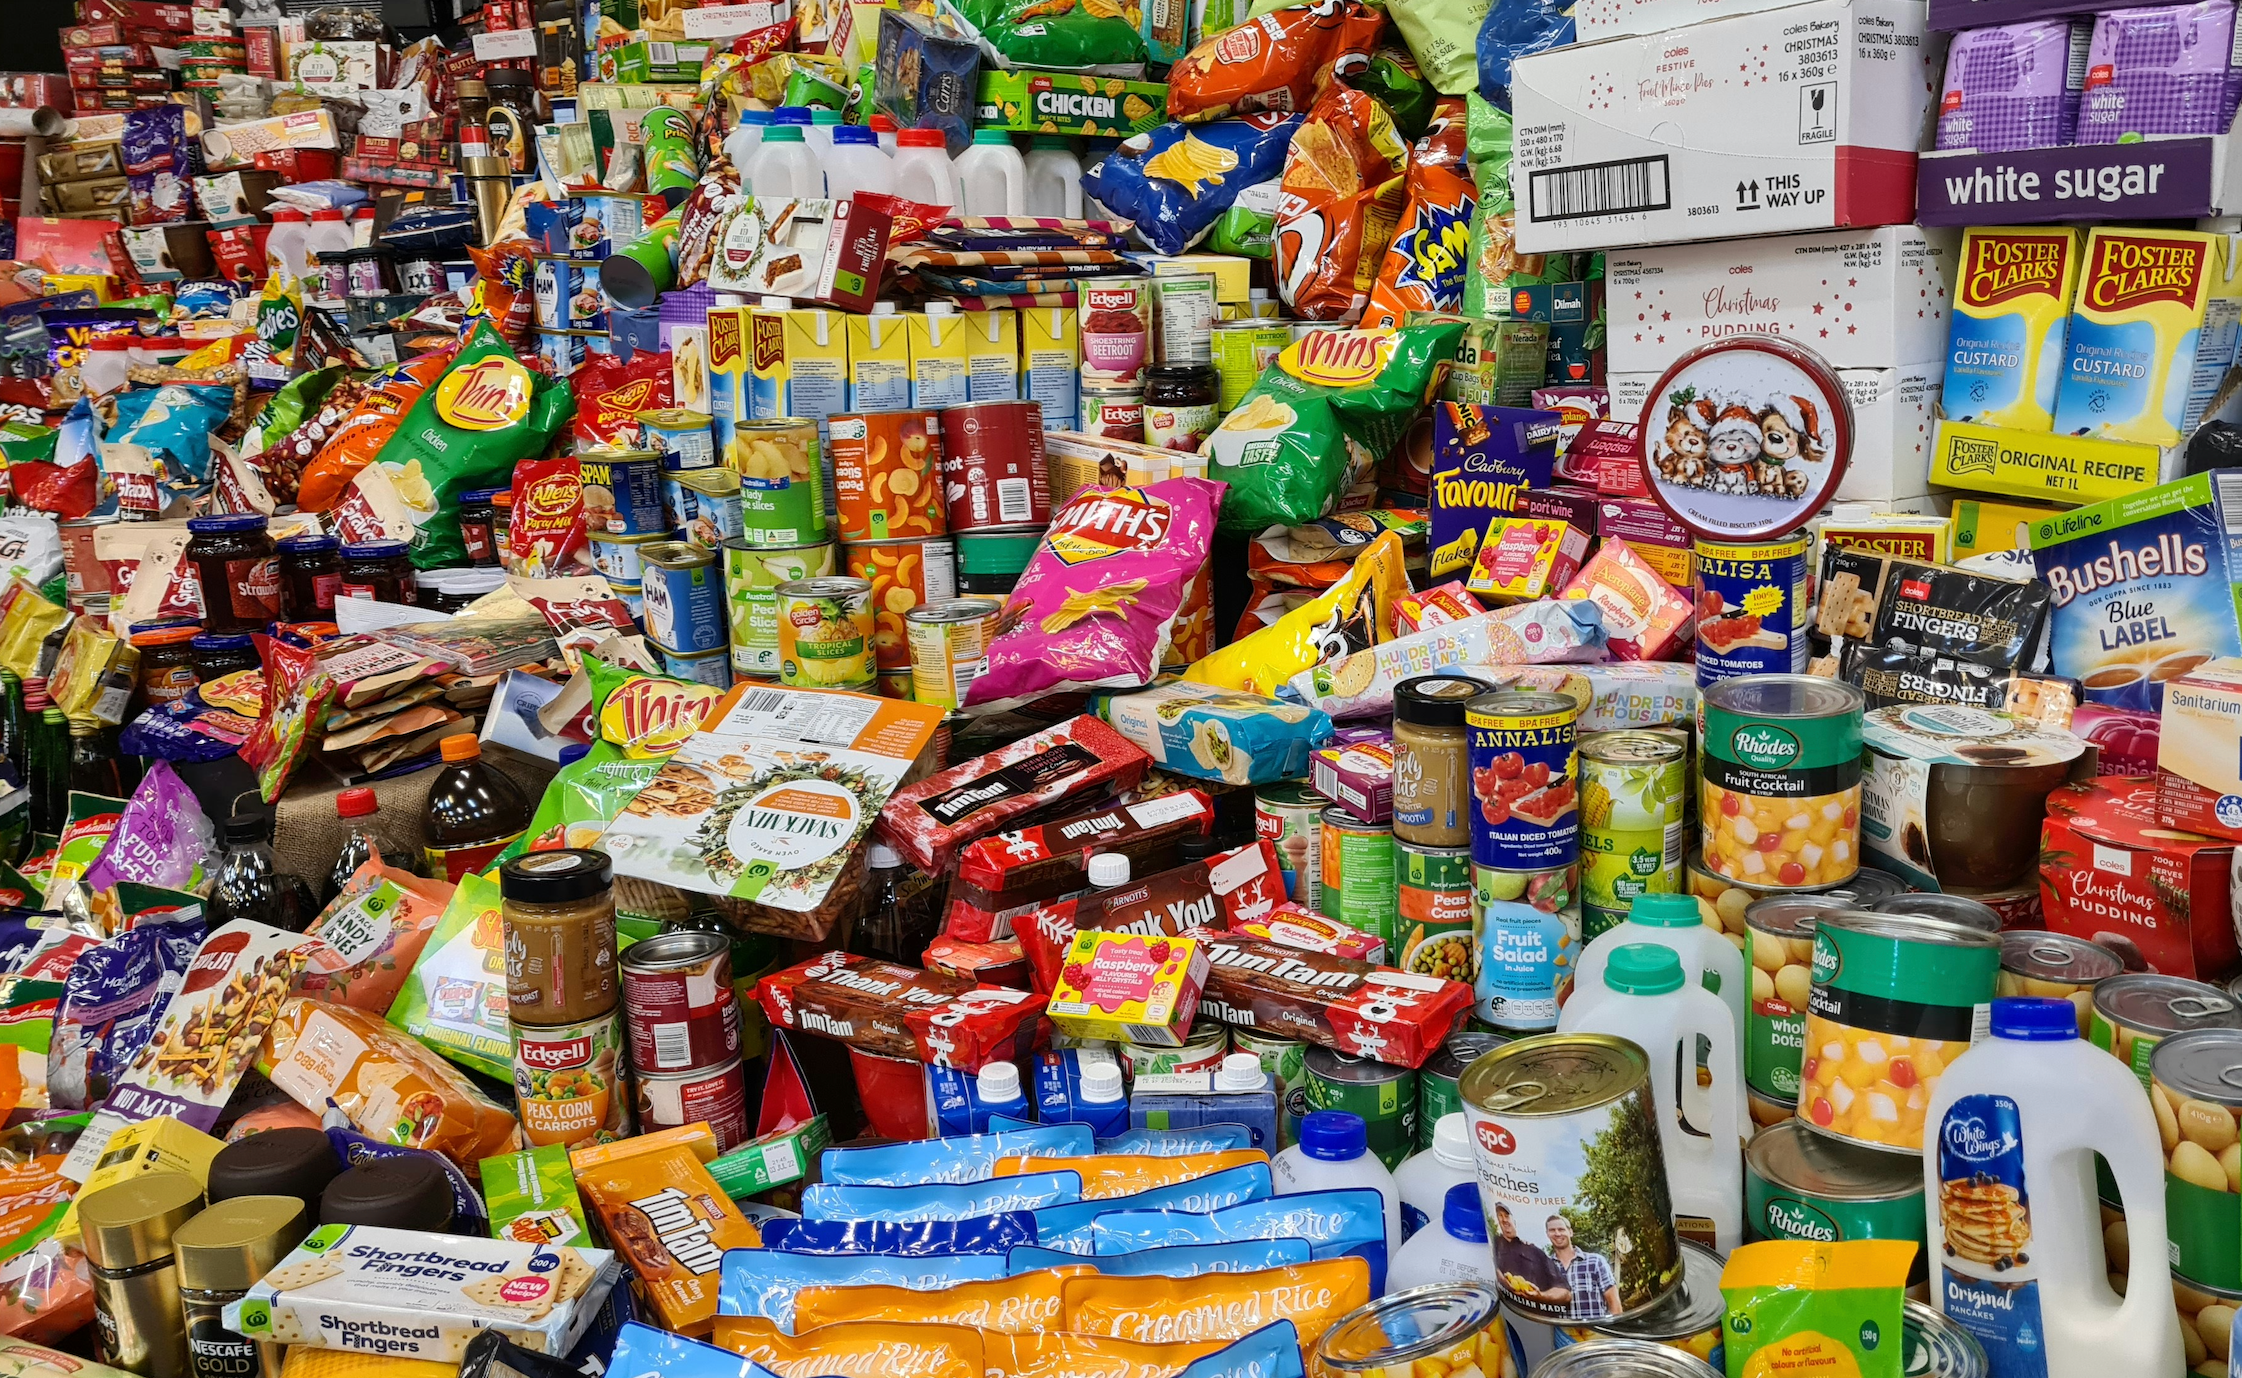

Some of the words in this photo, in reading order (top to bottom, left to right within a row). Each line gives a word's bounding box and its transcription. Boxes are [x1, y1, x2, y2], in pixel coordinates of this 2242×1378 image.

[702, 11, 728, 19] CHRISTMAS
[1783, 24, 1808, 36] coles
[1809, 20, 1839, 35] Bakery
[1664, 46, 1689, 58] coles
[1784, 35, 1839, 53] CHRISTMAS
[1656, 60, 1695, 73] FESTIVE
[1798, 50, 1838, 65] 3803613
[934, 73, 950, 114] Carr's
[2091, 94, 2125, 110] white
[1037, 91, 1115, 119] CHICKEN
[1945, 117, 1973, 132] white
[2089, 109, 2120, 123] sugar
[629, 120, 638, 143] RICE
[1801, 129, 1834, 141] FRAGILE
[1944, 131, 1970, 145] sugar
[1766, 174, 1801, 191] THIS
[1945, 166, 2040, 204] white
[2055, 163, 2164, 202] sugar
[1766, 191, 1801, 208] WAY
[1804, 189, 1825, 204] UP
[1687, 205, 1720, 216] 3803613
[1553, 219, 1568, 229] 193
[1575, 217, 1601, 227] 10645
[1608, 214, 1635, 224] 31454
[1642, 212, 1647, 221] 6
[1973, 239, 2060, 275] FOSTER
[2097, 241, 2195, 278] FOSTER
[536, 279, 554, 294] HAM
[1969, 260, 2058, 302] CLARK'S
[1087, 290, 1133, 308] Edgell
[1554, 300, 1581, 309] Dilmah
[1702, 286, 1780, 319] Christmas
[1089, 336, 1137, 345] SHOESTRING
[1512, 334, 1538, 343] Nerada
[1092, 343, 1135, 357] BEETROOT
[1299, 330, 1387, 374] Thins
[1953, 351, 2019, 368] CUSTARD
[1451, 371, 1463, 382] Cup
[1464, 374, 1479, 384] Bags
[2072, 358, 2146, 378] CUSTARD
[1269, 375, 1307, 395] Chicken
[1467, 390, 1481, 401] 50
[420, 427, 448, 452] Chicken
[1243, 448, 1279, 467] TASTY
[1464, 453, 1527, 481] Cadbury
[2000, 450, 2078, 474] ORIGINAL
[2083, 461, 2145, 482] RECIPE
[580, 463, 611, 485] SPAM
[2045, 474, 2065, 489] NET
[2068, 478, 2079, 490] 1L
[530, 483, 578, 505] Allen's
[524, 518, 554, 531] Party
[555, 515, 573, 528] Mix
[1049, 495, 1170, 542] SMITH'S
[2053, 511, 2103, 537] Lifeline
[1434, 546, 1472, 564] flake
[1498, 539, 1540, 555] Raspberry
[1752, 550, 1770, 558] BPA
[1772, 547, 1792, 557] FREE
[2047, 532, 2209, 608] Bushells
[645, 584, 667, 610] HAM
[2088, 598, 2103, 607] OUR
[2104, 591, 2126, 603] CUPPA
[2128, 586, 2149, 596] SINCE
[2152, 582, 2172, 591] 1883
[791, 605, 819, 618] golden
[1895, 600, 1982, 625] SHORTBREAD
[2105, 598, 2156, 624] Blue
[1891, 613, 1979, 642] FINGERS
[2099, 616, 2177, 652] LABEL
[807, 641, 853, 651] TROPICAL
[816, 647, 845, 656] SLICES
[1380, 637, 1456, 668] HUNDREDS
[2172, 690, 2241, 714] Sanitarium
[1119, 714, 1148, 730] Original
[1519, 717, 1537, 728] BPA
[1538, 715, 1561, 726] FREE
[1475, 725, 1578, 748] ANNALISA
[1736, 733, 1796, 757] Rhodes
[1751, 755, 1776, 764] Quality
[1725, 773, 1751, 788] Fruit
[1753, 778, 1804, 791] Cocktail
[1739, 770, 1757, 779] SOUTH
[933, 780, 1011, 818] TimTam
[740, 810, 786, 831] MIX
[786, 812, 846, 841] SNACK
[1397, 813, 1426, 823] SMOOTH
[1489, 830, 1519, 841] ITALIAN
[1520, 829, 1545, 841] DICED
[1547, 825, 1578, 839] TOMATOES
[2099, 859, 2125, 872] coles
[2152, 855, 2174, 867] 700g
[2151, 866, 2183, 879] SERVES
[2068, 870, 2156, 911] Christmas
[1166, 892, 1217, 931] You
[2070, 897, 2157, 929] PUDDING
[1274, 910, 1337, 940] Aeroplane
[1496, 929, 1542, 948] Fruit
[1110, 948, 1127, 956] Tasty
[1261, 945, 1301, 959] ARNOTT'S
[1492, 946, 1548, 963] Salad
[1093, 958, 1159, 976] Raspberry
[1205, 941, 1361, 989] TimTam
[1101, 971, 1138, 979] FLAVOURED
[1113, 977, 1143, 985] CRYSTALS
[820, 969, 904, 996] Thank
[903, 987, 953, 1005] You
[1767, 1001, 1787, 1013] coles
[797, 1008, 854, 1037] TimTam
[872, 1021, 900, 1035] Original
[407, 1024, 424, 1036] The
[424, 1025, 473, 1047] ORIGINAL
[293, 1049, 318, 1070] BBQ
[521, 1041, 586, 1066] Edgell
[319, 1061, 337, 1088] Tangy
[111, 1088, 135, 1108] NUT
[137, 1094, 186, 1119] MIX
[527, 1105, 555, 1120] PEAS,
[558, 1100, 593, 1118] CORN
[1994, 1098, 2014, 1110] 350g
[2190, 1108, 2213, 1126] 410g
[1478, 1127, 1508, 1150] spc
[1953, 1123, 1987, 1145] White
[1964, 1138, 2001, 1157] Wings
[1476, 1159, 1539, 1194] Peaches
[1496, 1190, 1530, 1204] MANGO
[1534, 1197, 1566, 1205] PUREE
[1283, 1210, 1344, 1237] Rice
[1768, 1202, 1834, 1243] Rhodes
[347, 1245, 511, 1275] Shortbread
[360, 1259, 466, 1283] Fingers
[503, 1287, 540, 1299] Recipe
[508, 1280, 547, 1292] NEW
[671, 1280, 695, 1306] Caramel
[687, 1278, 704, 1299] Chewy
[1947, 1279, 2015, 1312] Original
[1000, 1293, 1061, 1324] Rice
[1539, 1303, 1567, 1313] MADE
[1949, 1304, 1995, 1322] PANCAKES
[320, 1315, 440, 1340] Shortbread
[342, 1332, 420, 1354] Fingers
[1782, 1348, 1792, 1356] No
[1794, 1344, 1822, 1356] artificial
[1453, 1348, 1472, 1362] 825g
[197, 1356, 250, 1374] GOLD
